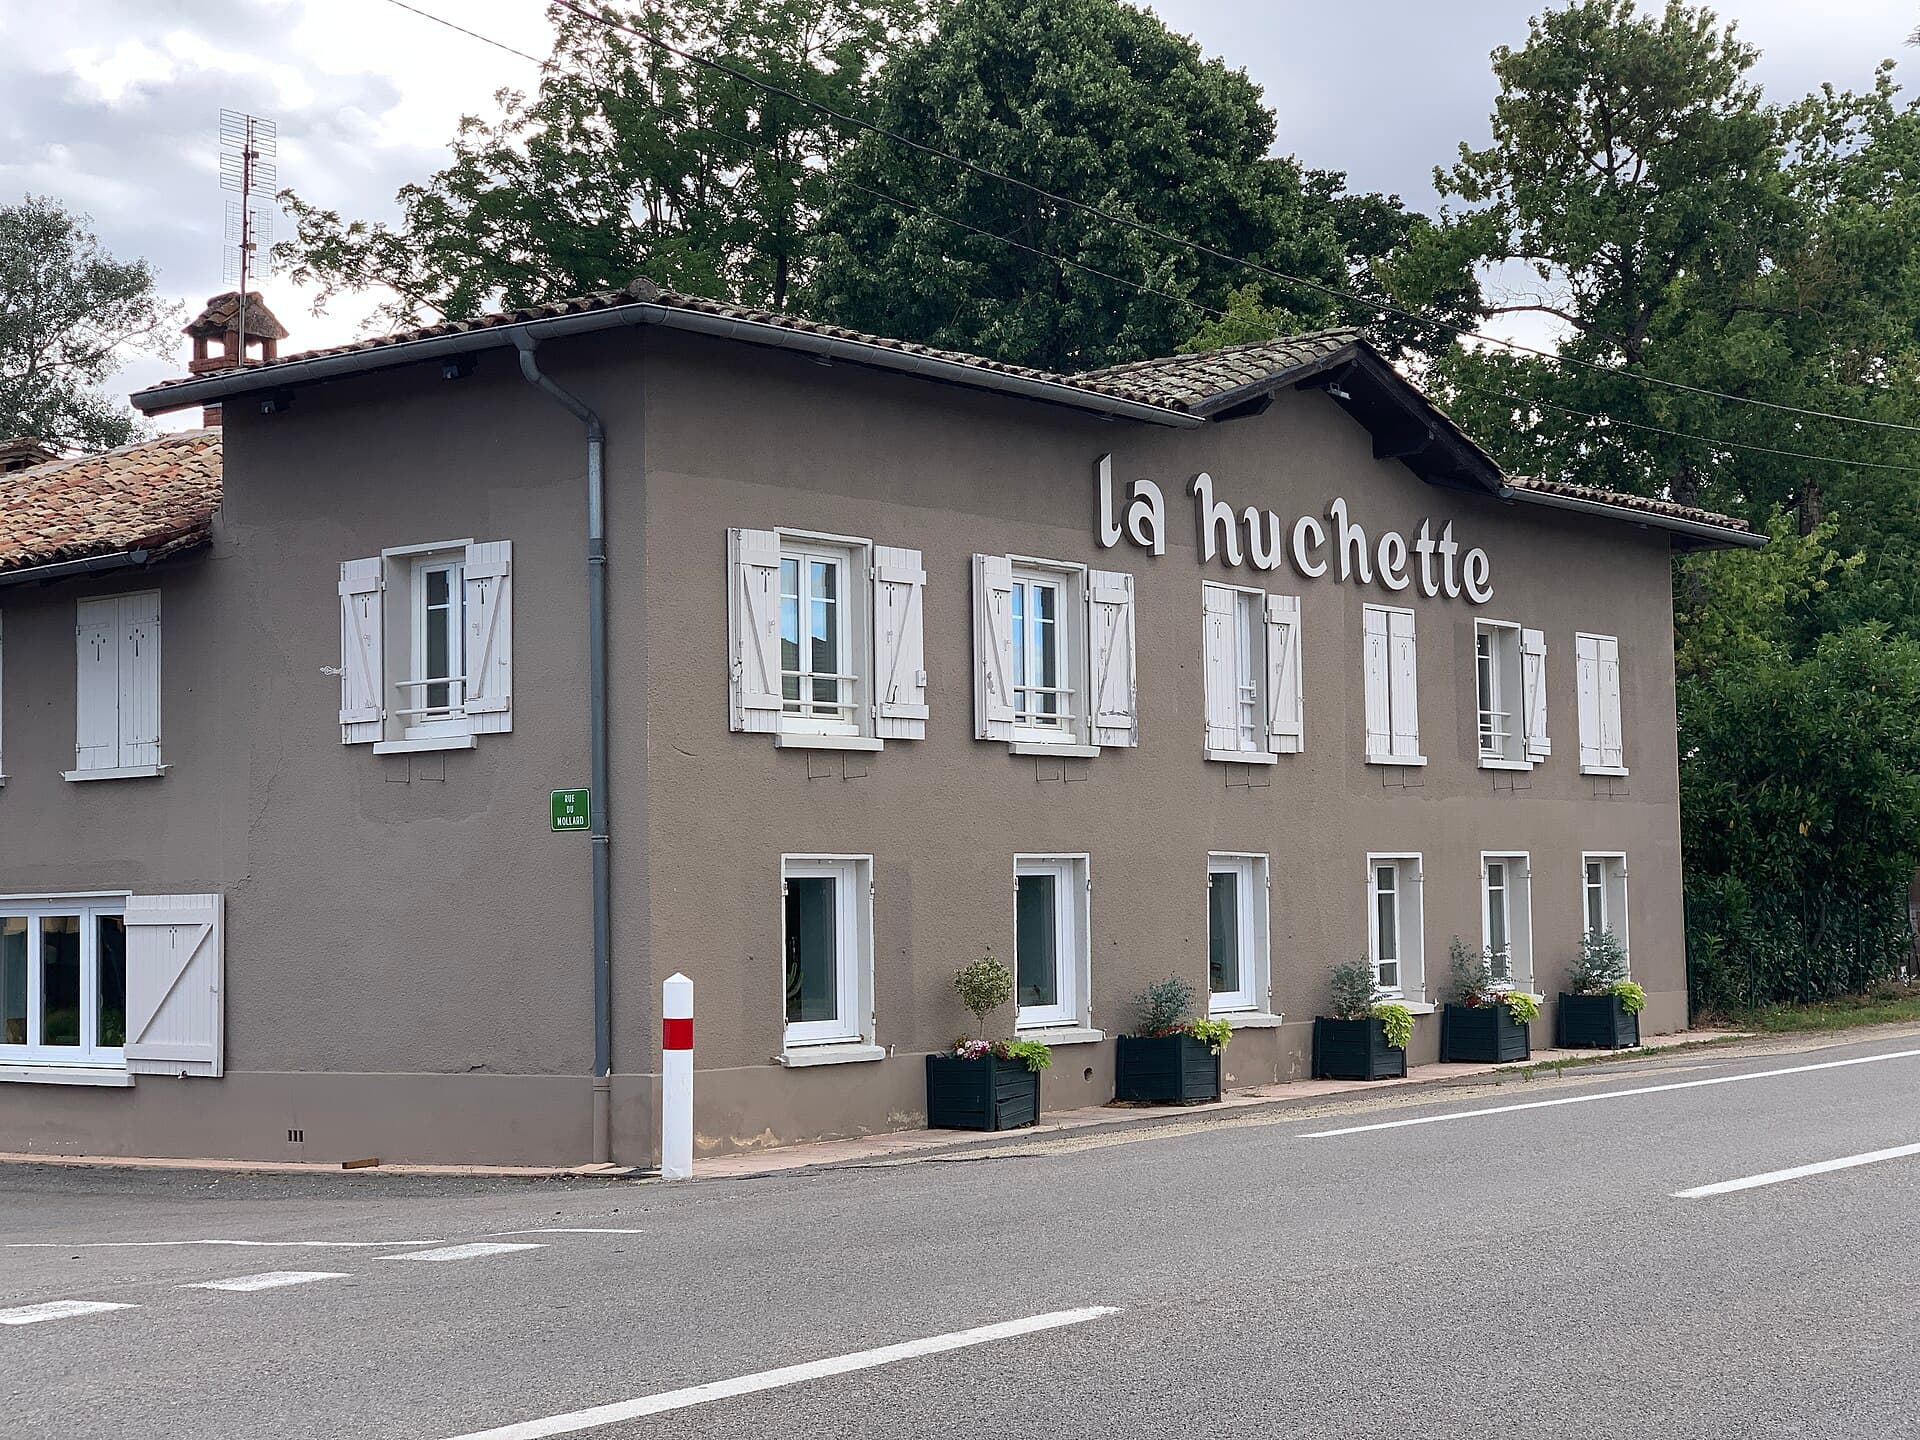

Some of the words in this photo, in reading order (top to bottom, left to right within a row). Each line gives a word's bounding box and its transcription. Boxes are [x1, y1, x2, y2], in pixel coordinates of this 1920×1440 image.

[1097, 452, 1166, 557] la
[1191, 471, 1495, 605] huchette
[564, 794, 575, 803] RUE
[566, 805, 574, 814] DU
[557, 815, 584, 826] MOLLARD
